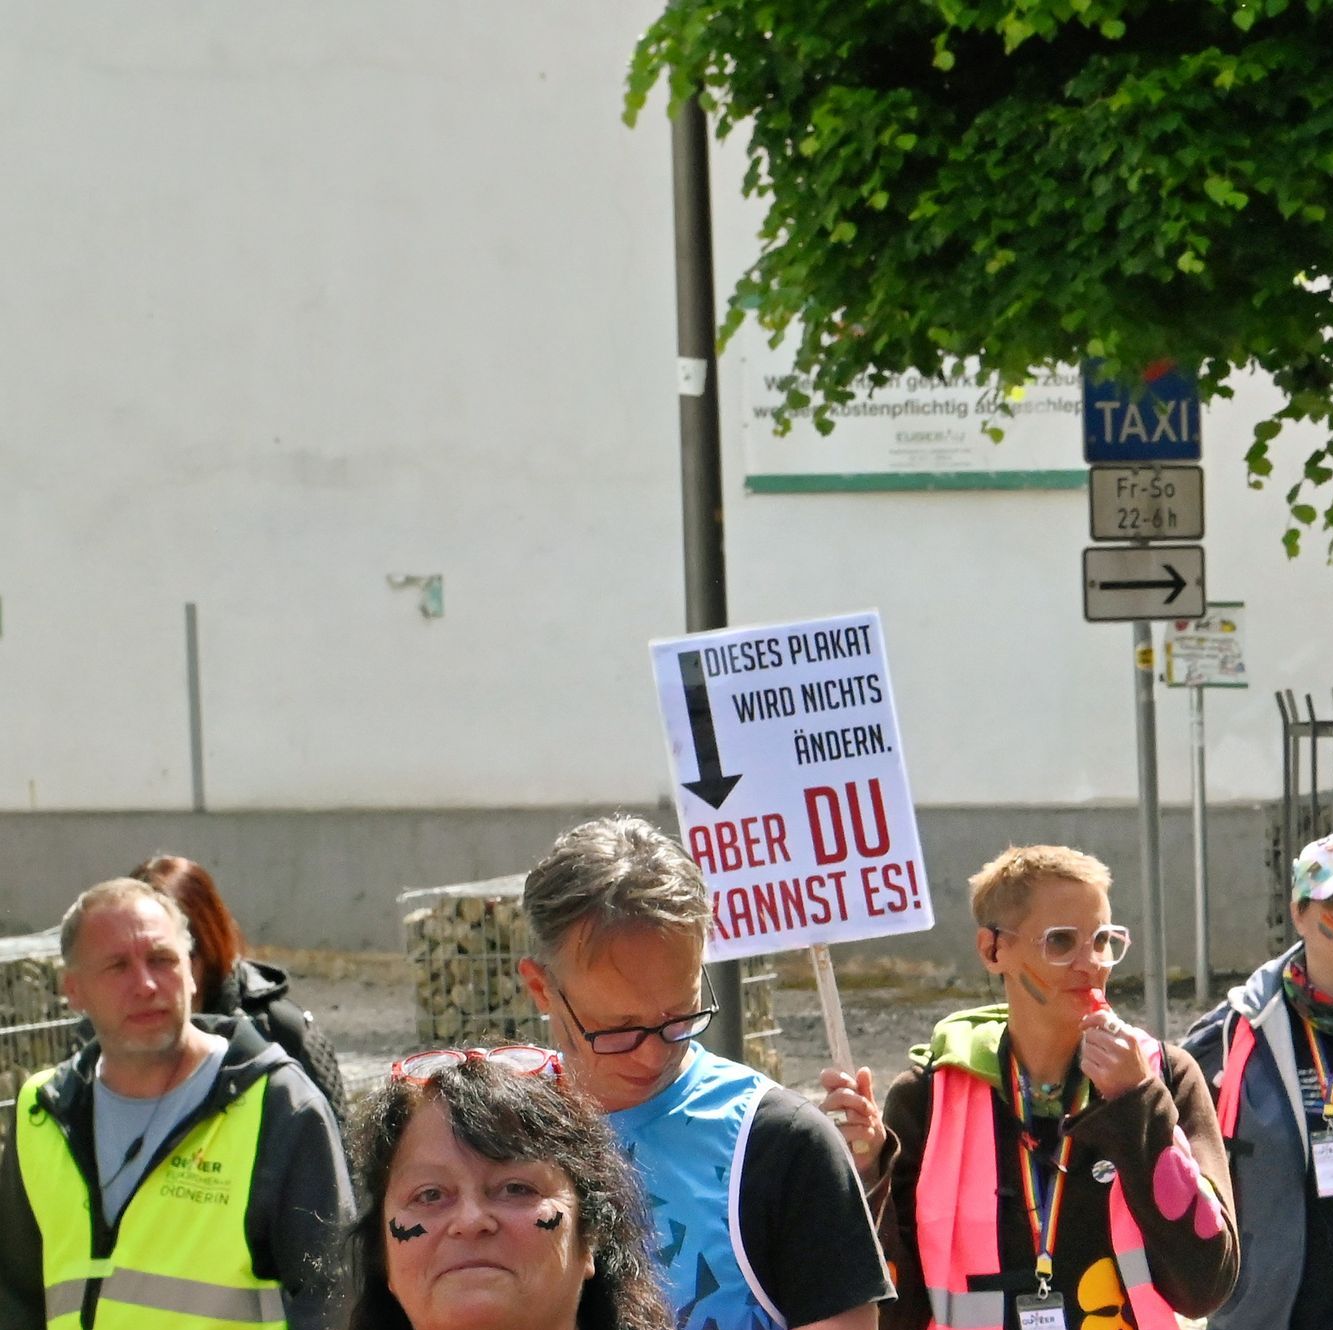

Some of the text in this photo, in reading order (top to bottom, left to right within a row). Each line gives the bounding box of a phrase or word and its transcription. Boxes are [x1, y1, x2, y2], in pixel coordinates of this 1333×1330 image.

[829, 397, 968, 418] kostenpflichtig
[1095, 401, 1190, 444] TAXI
[1116, 477, 1176, 498] Fr-So
[704, 624, 872, 677] DIESES PLAKAT
[732, 673, 882, 724] WIRD NICHTS
[794, 723, 892, 766] ÄNDERN.
[688, 777, 891, 875] ABER DU
[711, 860, 922, 941] KANNST ES!
